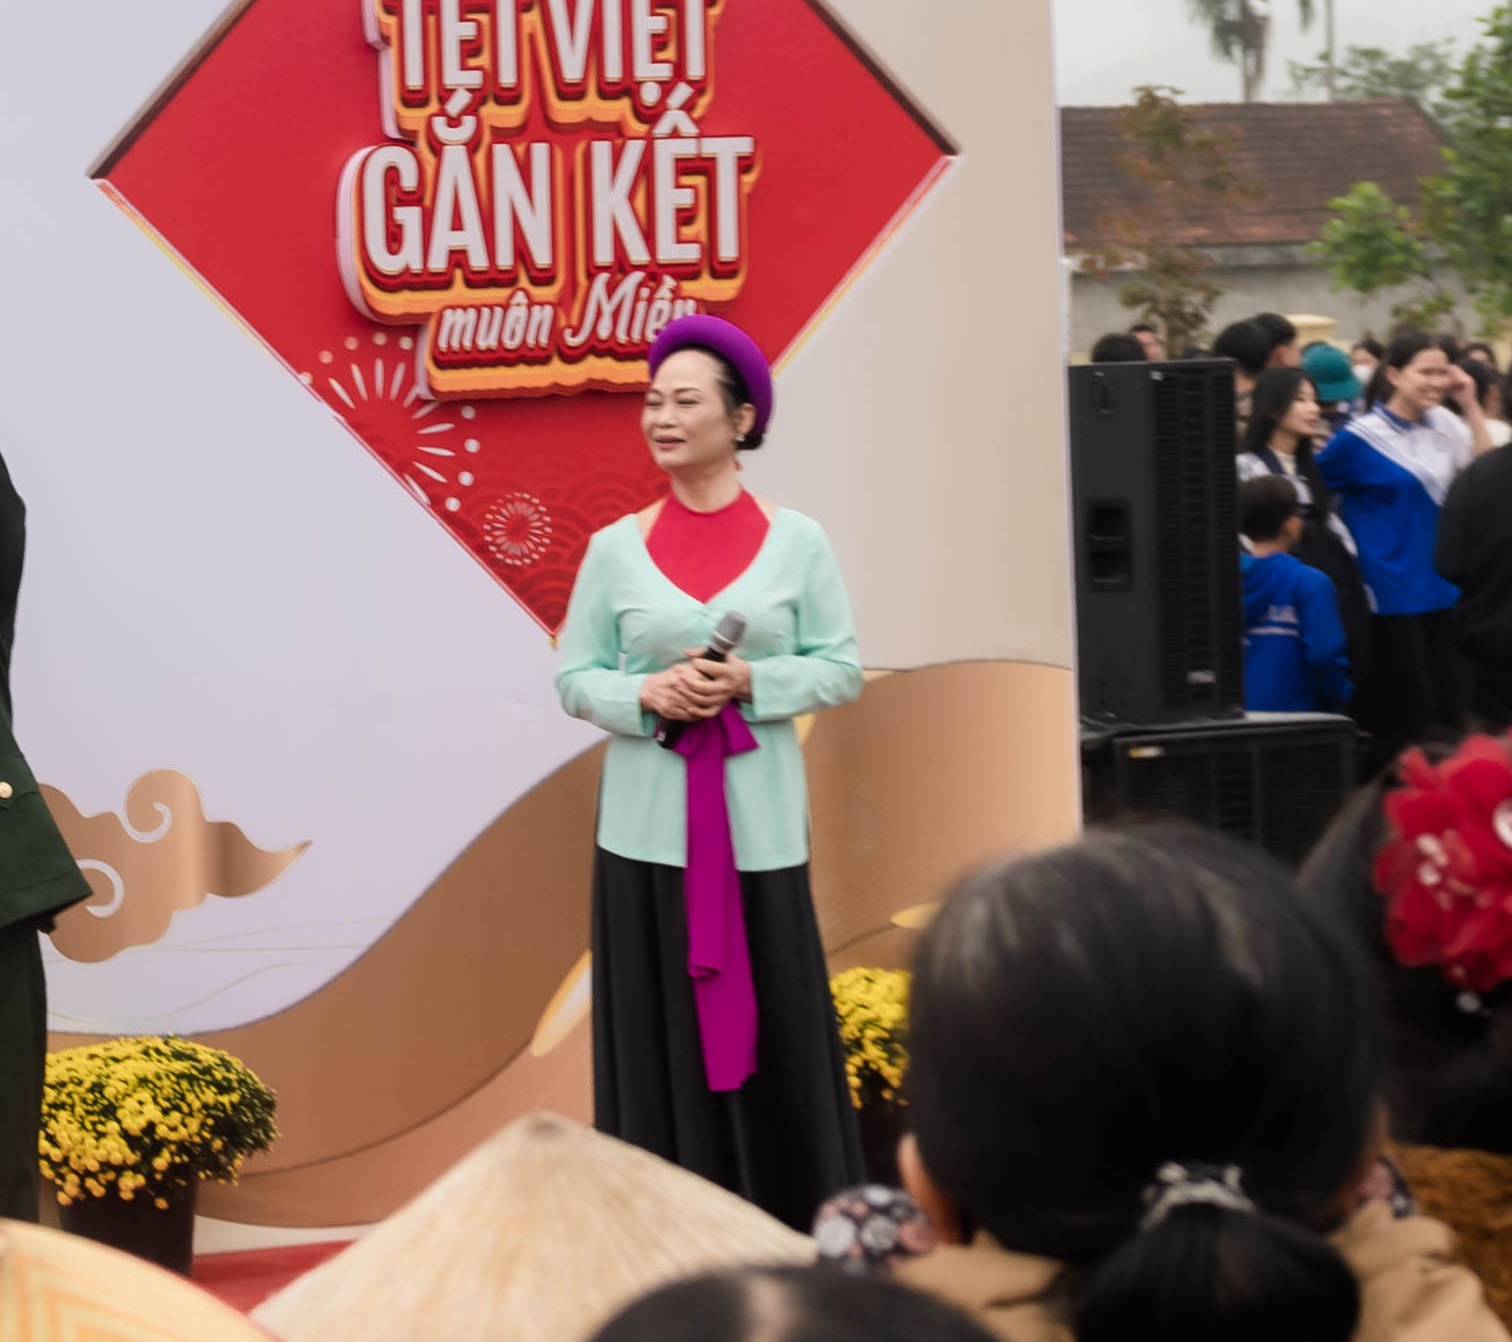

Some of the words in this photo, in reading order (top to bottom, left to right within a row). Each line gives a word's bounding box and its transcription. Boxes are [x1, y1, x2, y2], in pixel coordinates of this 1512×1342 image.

[362, 88, 554, 276] GẮN
[590, 83, 754, 266] KẾT
[437, 290, 554, 352] muôn
